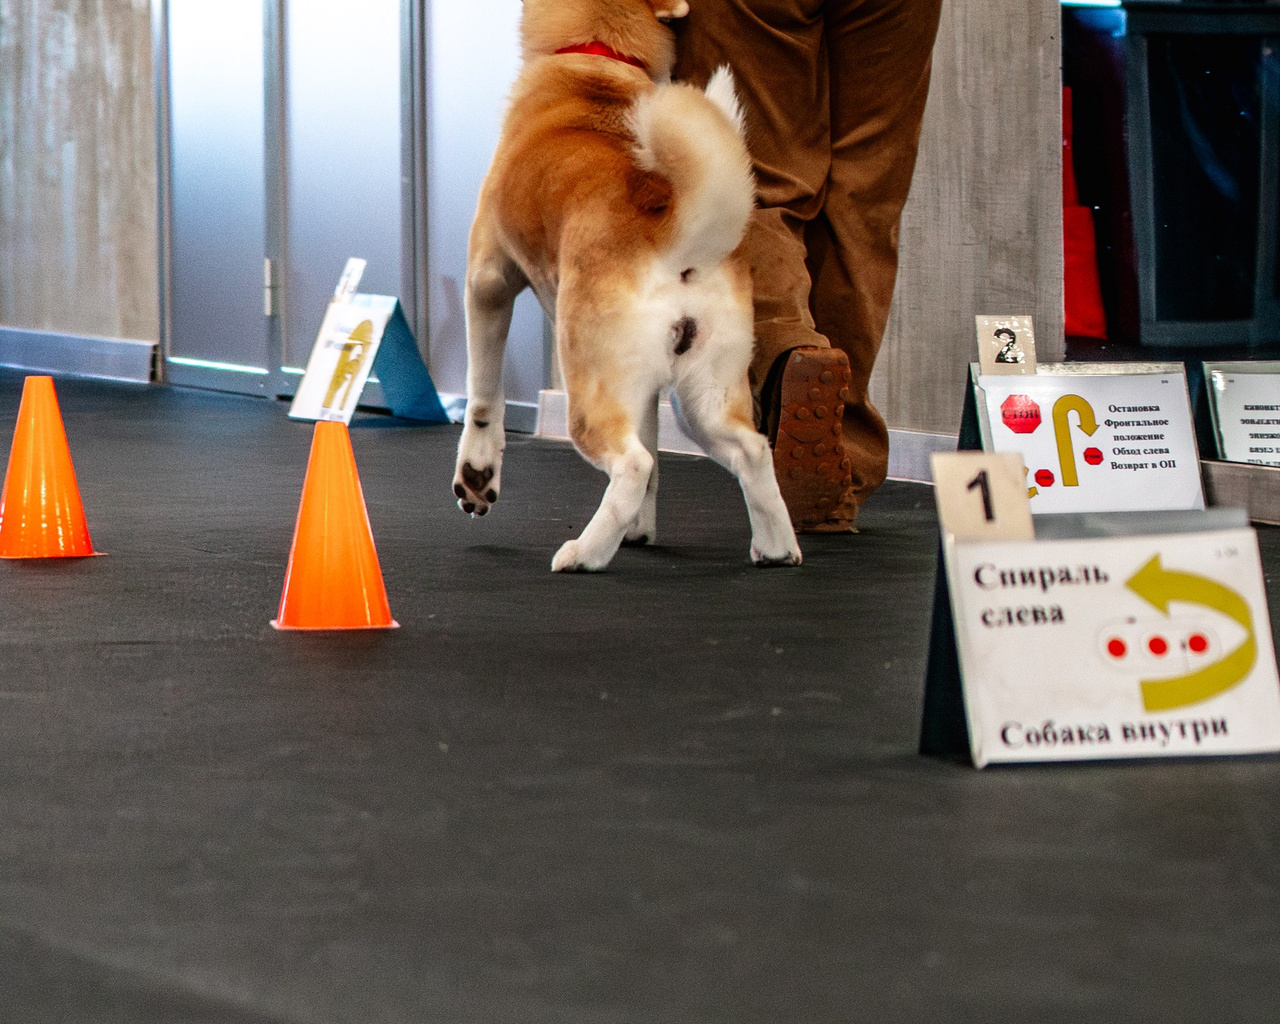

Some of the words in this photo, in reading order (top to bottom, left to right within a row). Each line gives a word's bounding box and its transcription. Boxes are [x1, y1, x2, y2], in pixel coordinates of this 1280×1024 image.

[993, 327, 1022, 364] 2
[1002, 409, 1039, 419] СТОП
[1108, 404, 1160, 413] Остановка
[1104, 419, 1169, 429] Фронтальное
[1113, 433, 1165, 441] положение
[1112, 446, 1141, 456] Обход
[1143, 447, 1170, 455] слева
[1110, 461, 1148, 471] Возврат
[1159, 459, 1177, 469] ОП
[966, 467, 996, 524] 1
[973, 562, 1110, 593] Спираль
[980, 603, 1066, 628] слева
[1000, 719, 1111, 749] Собака
[1121, 716, 1229, 747] внутри
